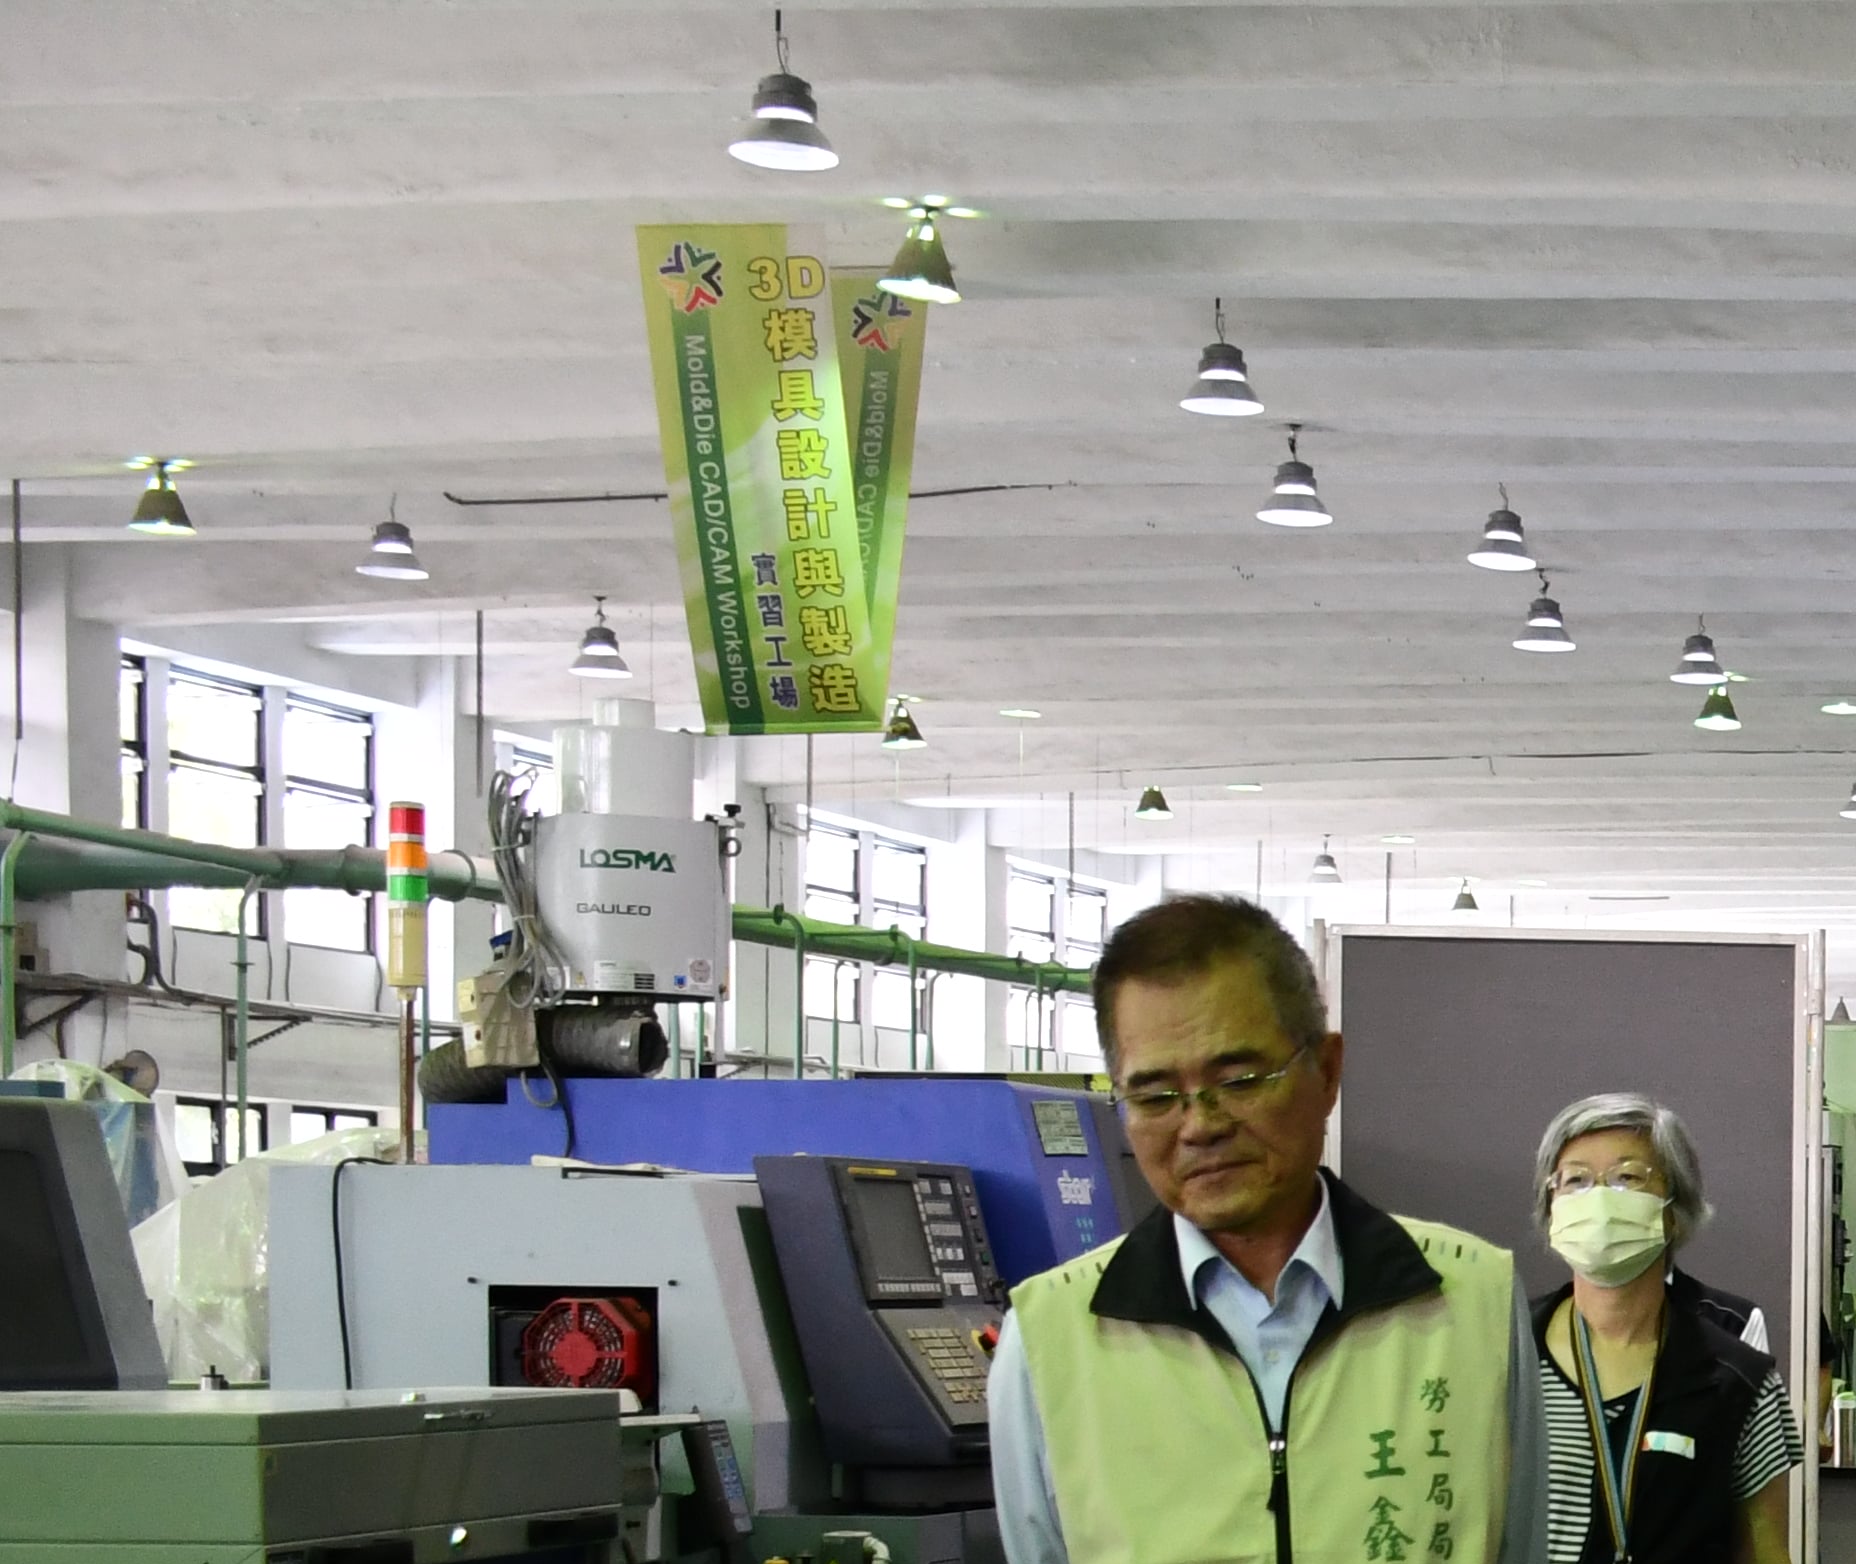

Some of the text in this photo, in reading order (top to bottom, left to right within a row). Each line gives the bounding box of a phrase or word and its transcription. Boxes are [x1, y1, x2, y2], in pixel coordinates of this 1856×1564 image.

[684, 334, 752, 710] Mold&Die CAD/CAM Workshop
[747, 254, 861, 716] 3D模具設計與製造
[750, 552, 799, 711] 實習工場
[579, 848, 677, 874] LOSMA
